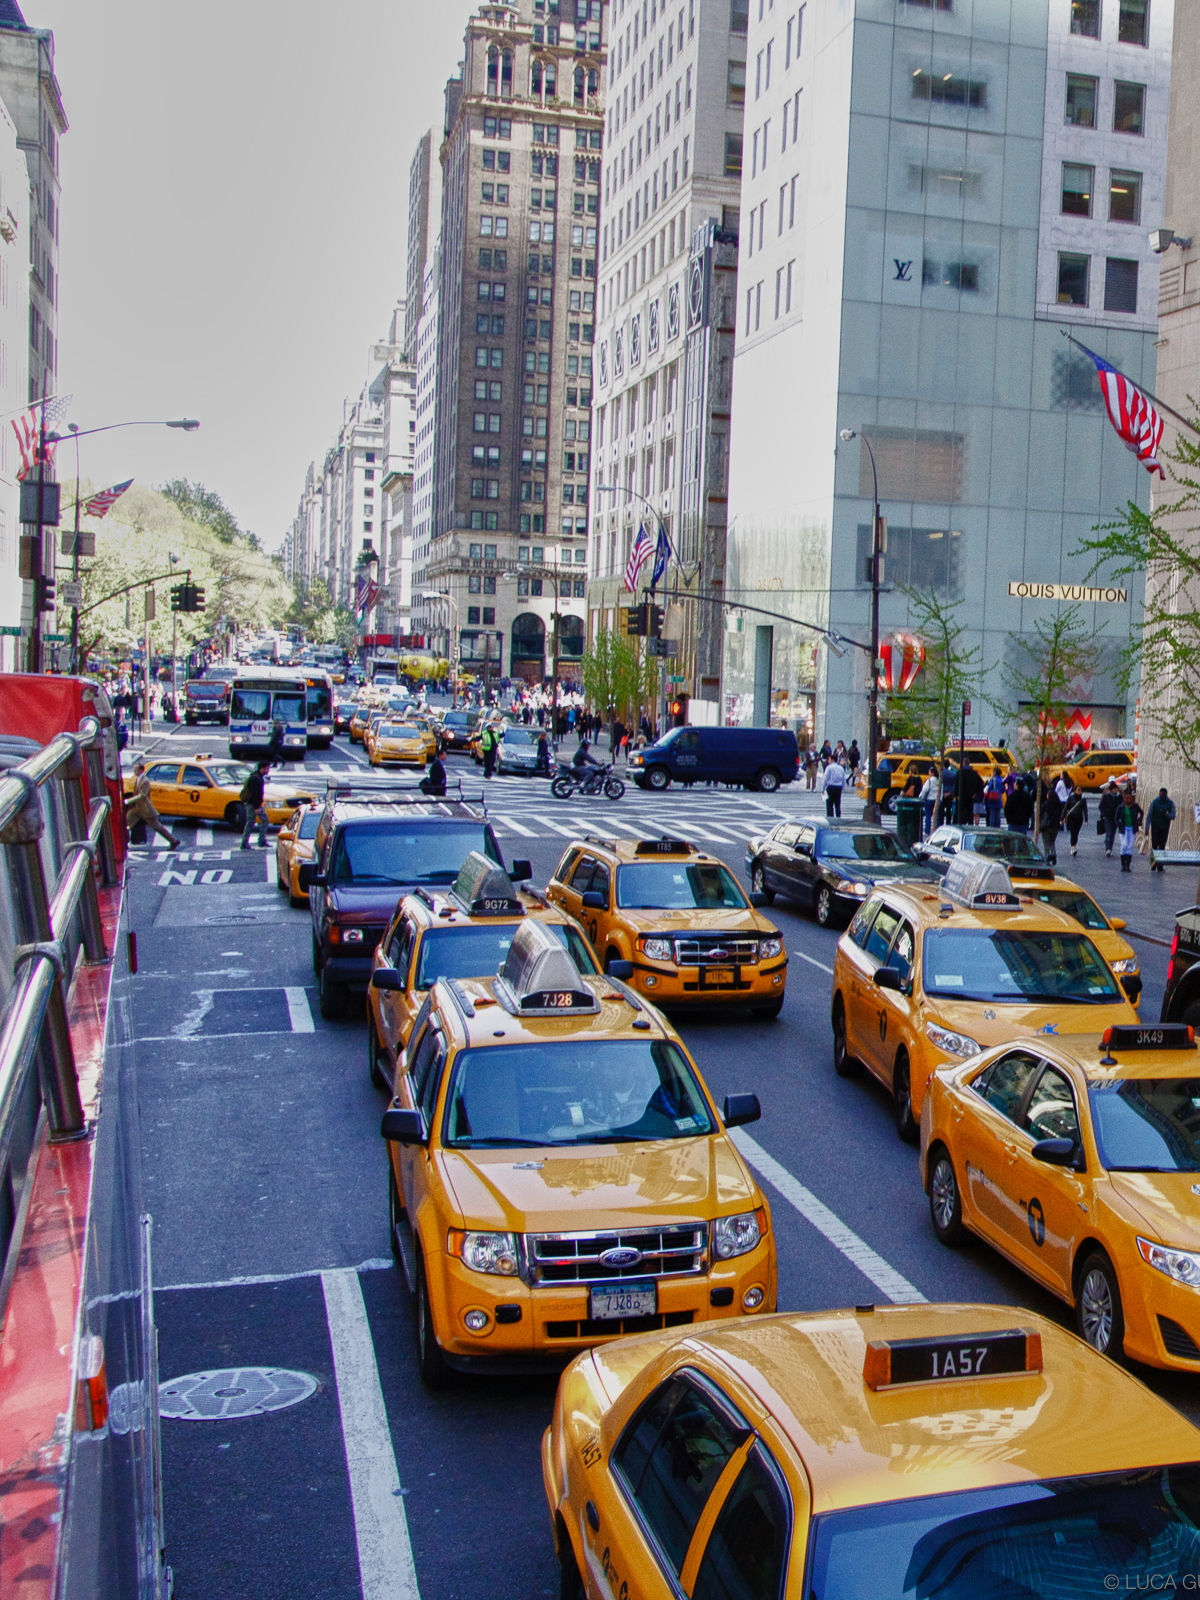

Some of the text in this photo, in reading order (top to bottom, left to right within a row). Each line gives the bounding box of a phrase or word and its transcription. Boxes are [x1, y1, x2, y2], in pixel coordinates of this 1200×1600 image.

[1008, 582, 1128, 602] LOUIS VUITTON
[484, 900, 509, 910] 9G72
[985, 894, 1007, 904] 8V38
[542, 994, 573, 1007] 7J28
[1136, 1030, 1164, 1044] 3K49
[931, 1346, 988, 1377] 1A57
